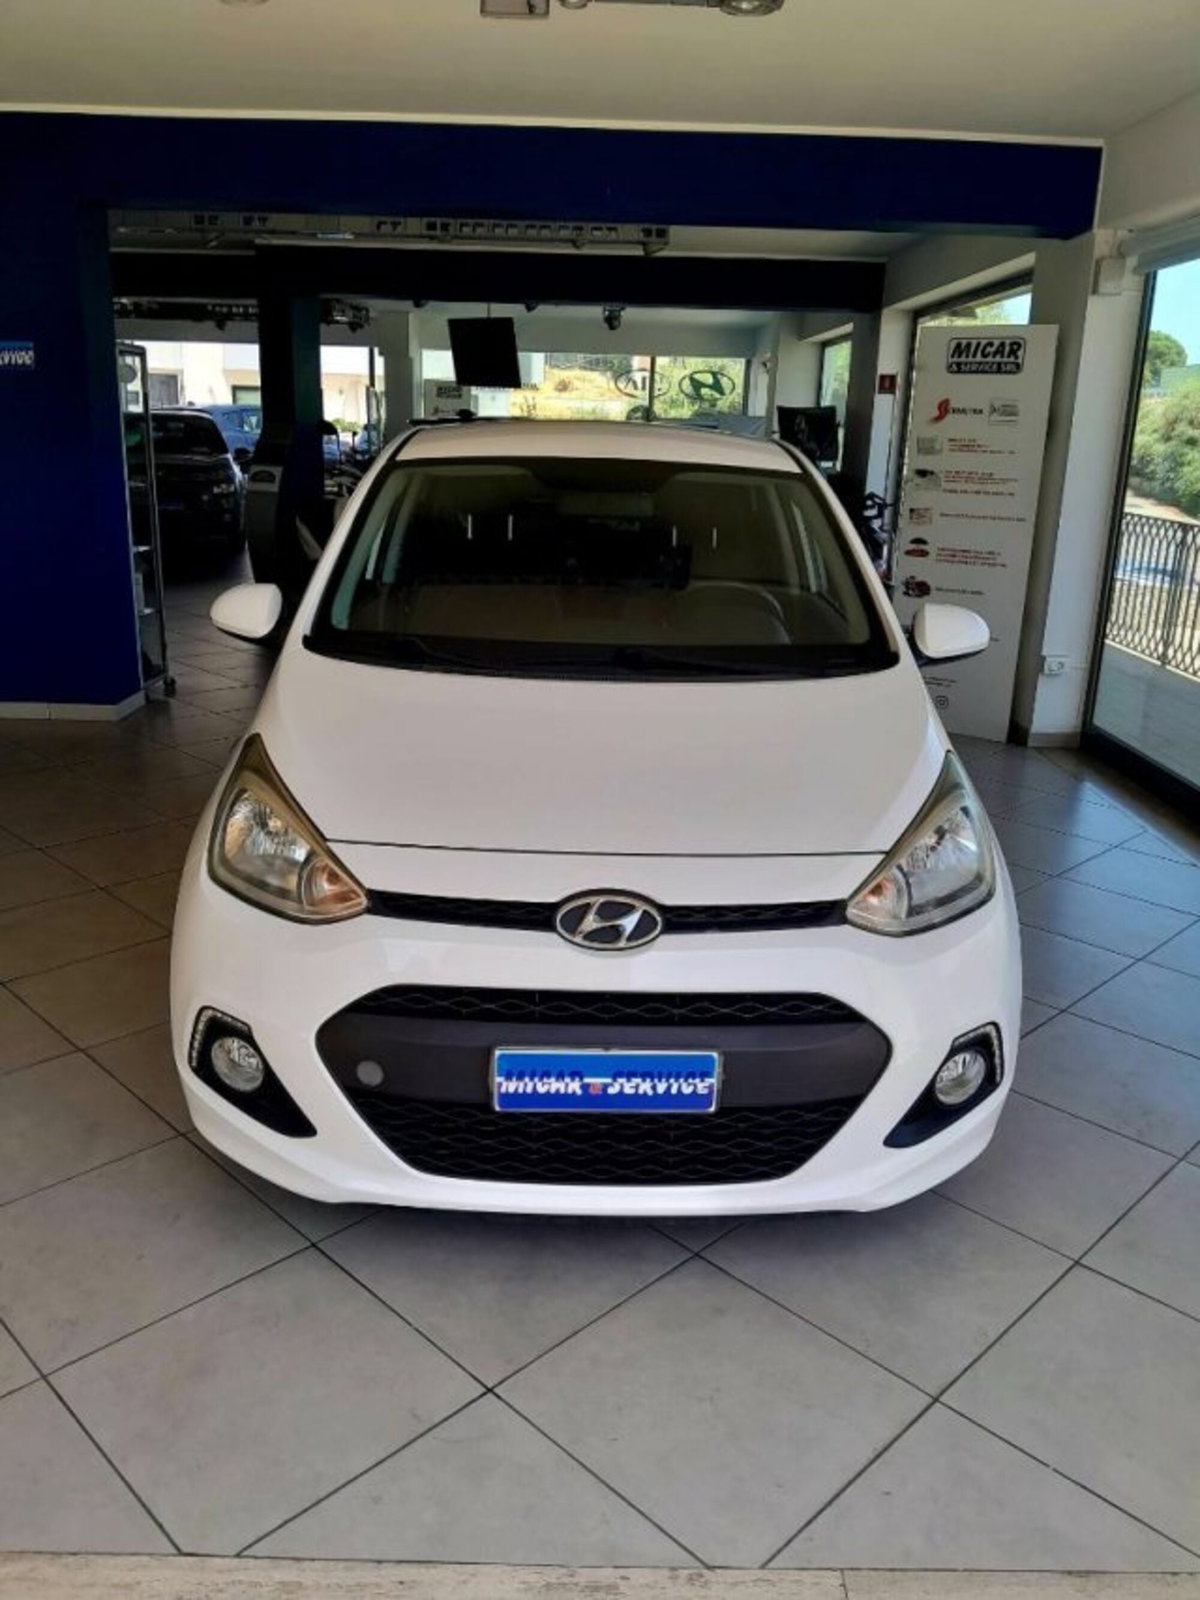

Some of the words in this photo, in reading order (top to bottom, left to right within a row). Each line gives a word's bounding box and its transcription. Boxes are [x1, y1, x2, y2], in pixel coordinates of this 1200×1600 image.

[950, 340, 1022, 361] MICAR
[960, 363, 997, 372] SERVICE
[499, 1069, 583, 1095] MICAR
[607, 1071, 712, 1096] SERVICE
